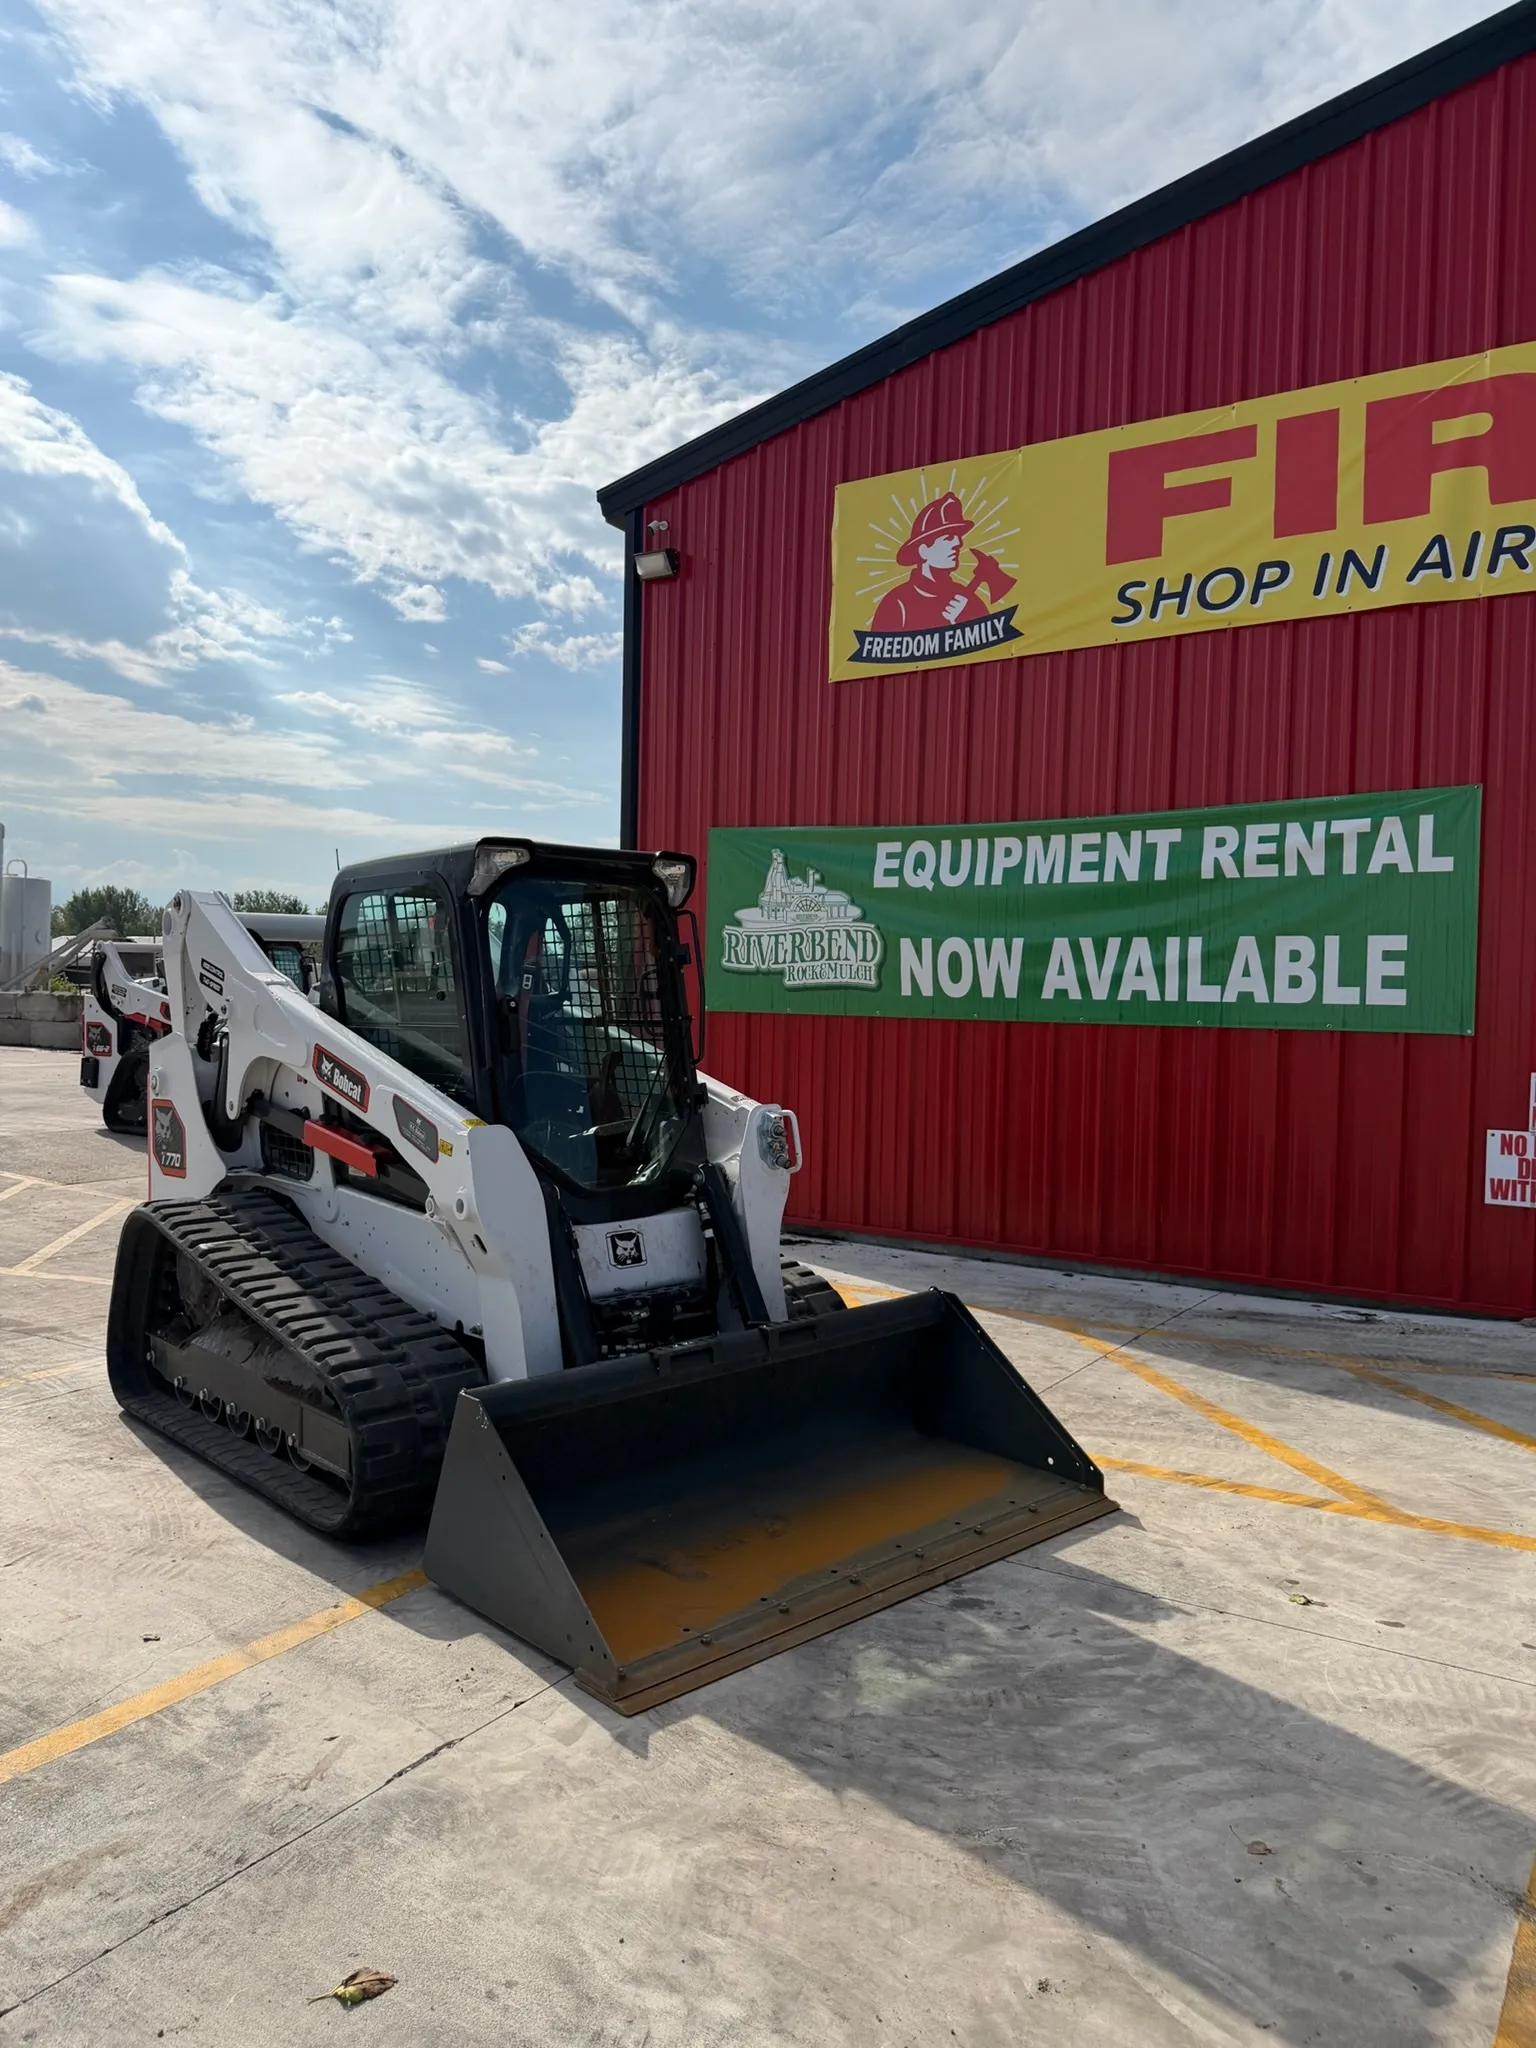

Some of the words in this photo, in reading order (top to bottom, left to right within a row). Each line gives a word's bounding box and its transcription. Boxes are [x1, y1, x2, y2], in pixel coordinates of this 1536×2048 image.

[1111, 560, 1293, 626] SHOP
[1313, 544, 1389, 600] IN
[1406, 524, 1536, 585] AIR
[862, 633, 939, 658] FREEDOM
[944, 616, 1006, 653] FAMILY
[872, 828, 1182, 891] EQUIPMENT
[1200, 814, 1454, 879] RENTAL
[724, 928, 880, 967] RIVERBEND
[900, 937, 1025, 999] NOW
[1041, 935, 1408, 1006] AVAILABLE
[333, 1068, 362, 1103] Bobcat
[1500, 1133, 1528, 1156] NO
